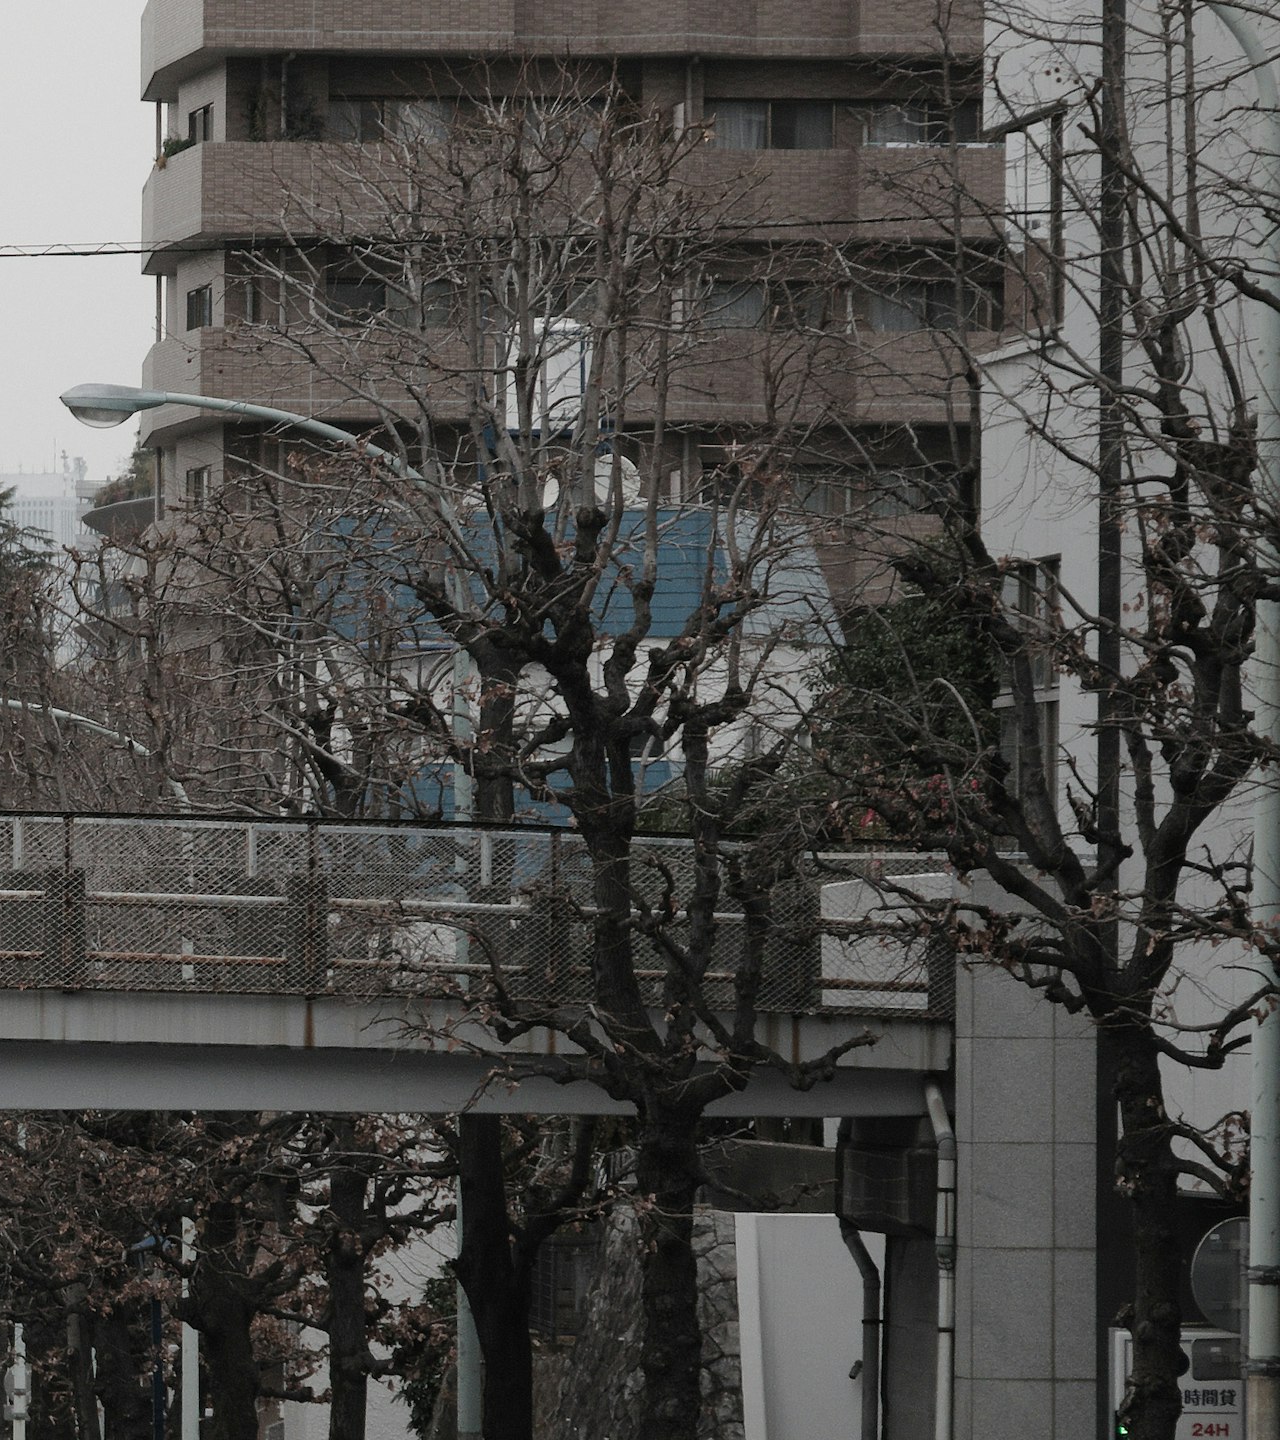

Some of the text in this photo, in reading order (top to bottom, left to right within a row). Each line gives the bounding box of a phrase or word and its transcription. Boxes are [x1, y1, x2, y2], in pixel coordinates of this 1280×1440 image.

[1184, 1388, 1237, 1407] 時間貸
[1192, 1422, 1229, 1437] 24H
